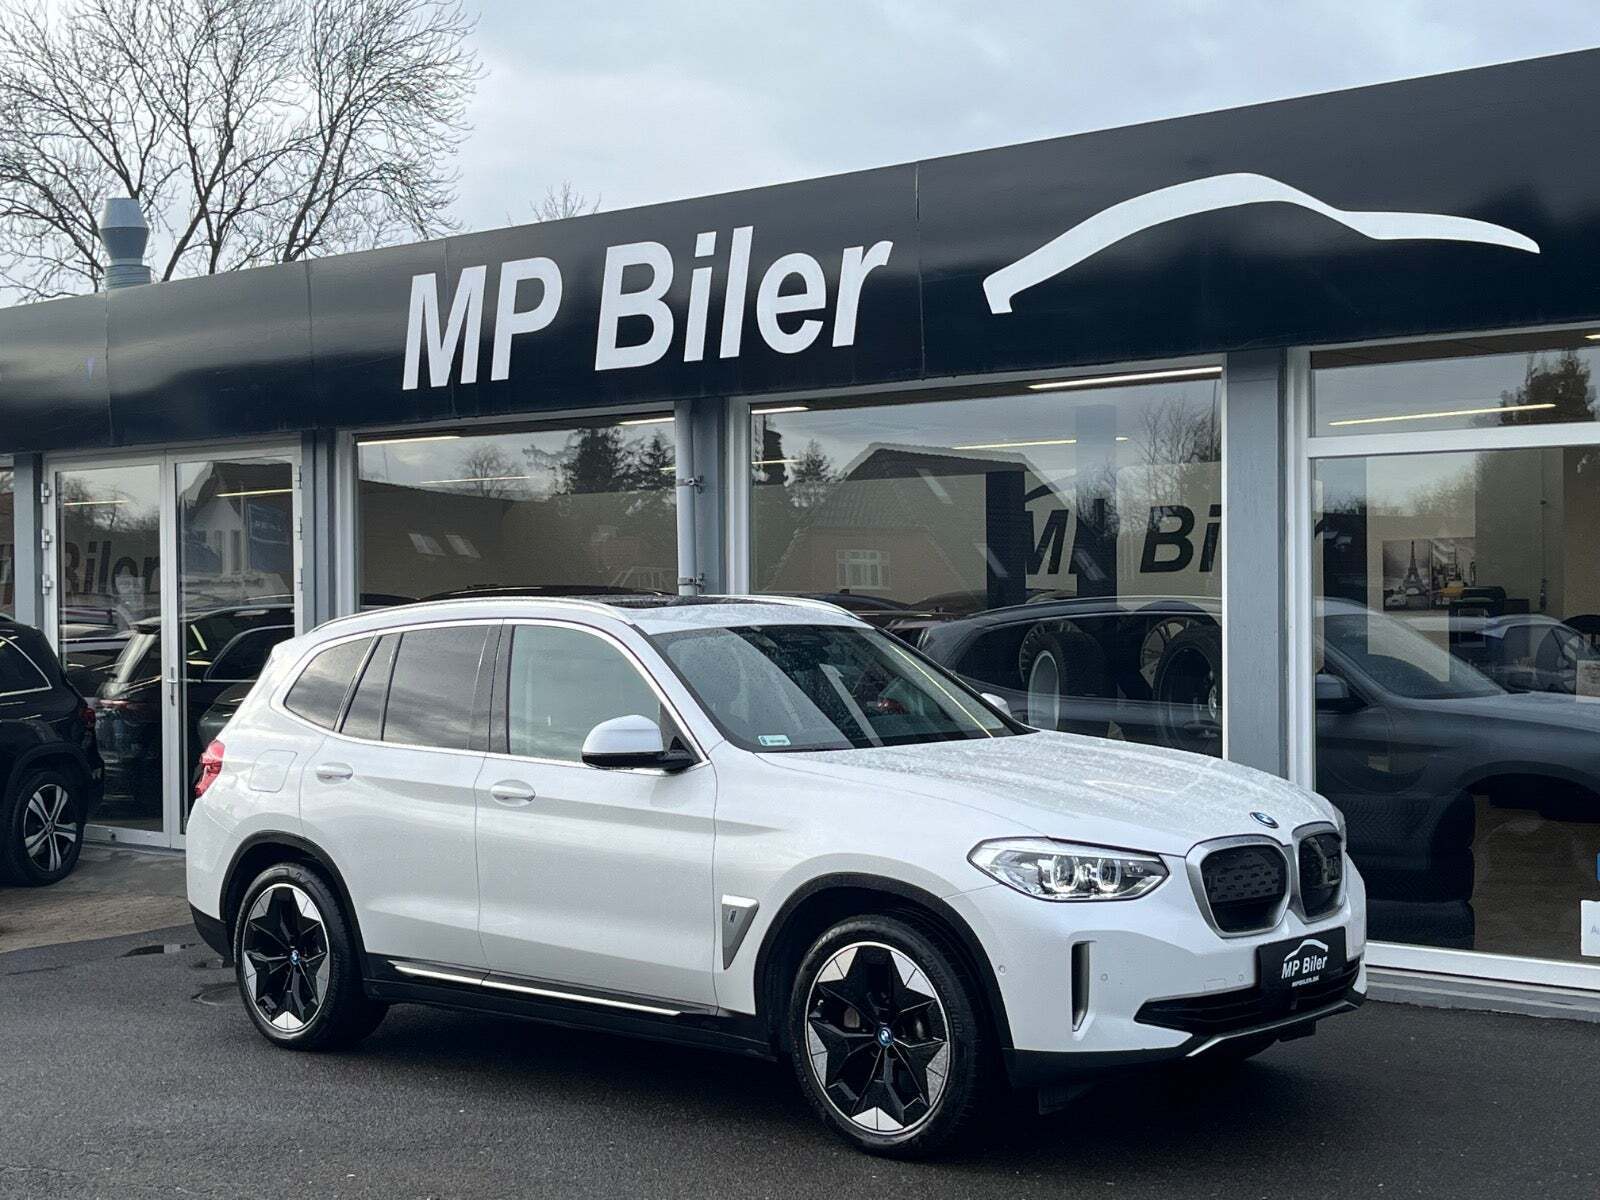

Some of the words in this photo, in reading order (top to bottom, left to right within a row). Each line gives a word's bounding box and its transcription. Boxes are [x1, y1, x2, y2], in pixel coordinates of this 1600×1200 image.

[403, 257, 562, 390] MP
[595, 226, 894, 371] Biler
[1281, 960, 1300, 979] MP
[1302, 955, 1328, 974] Biler
